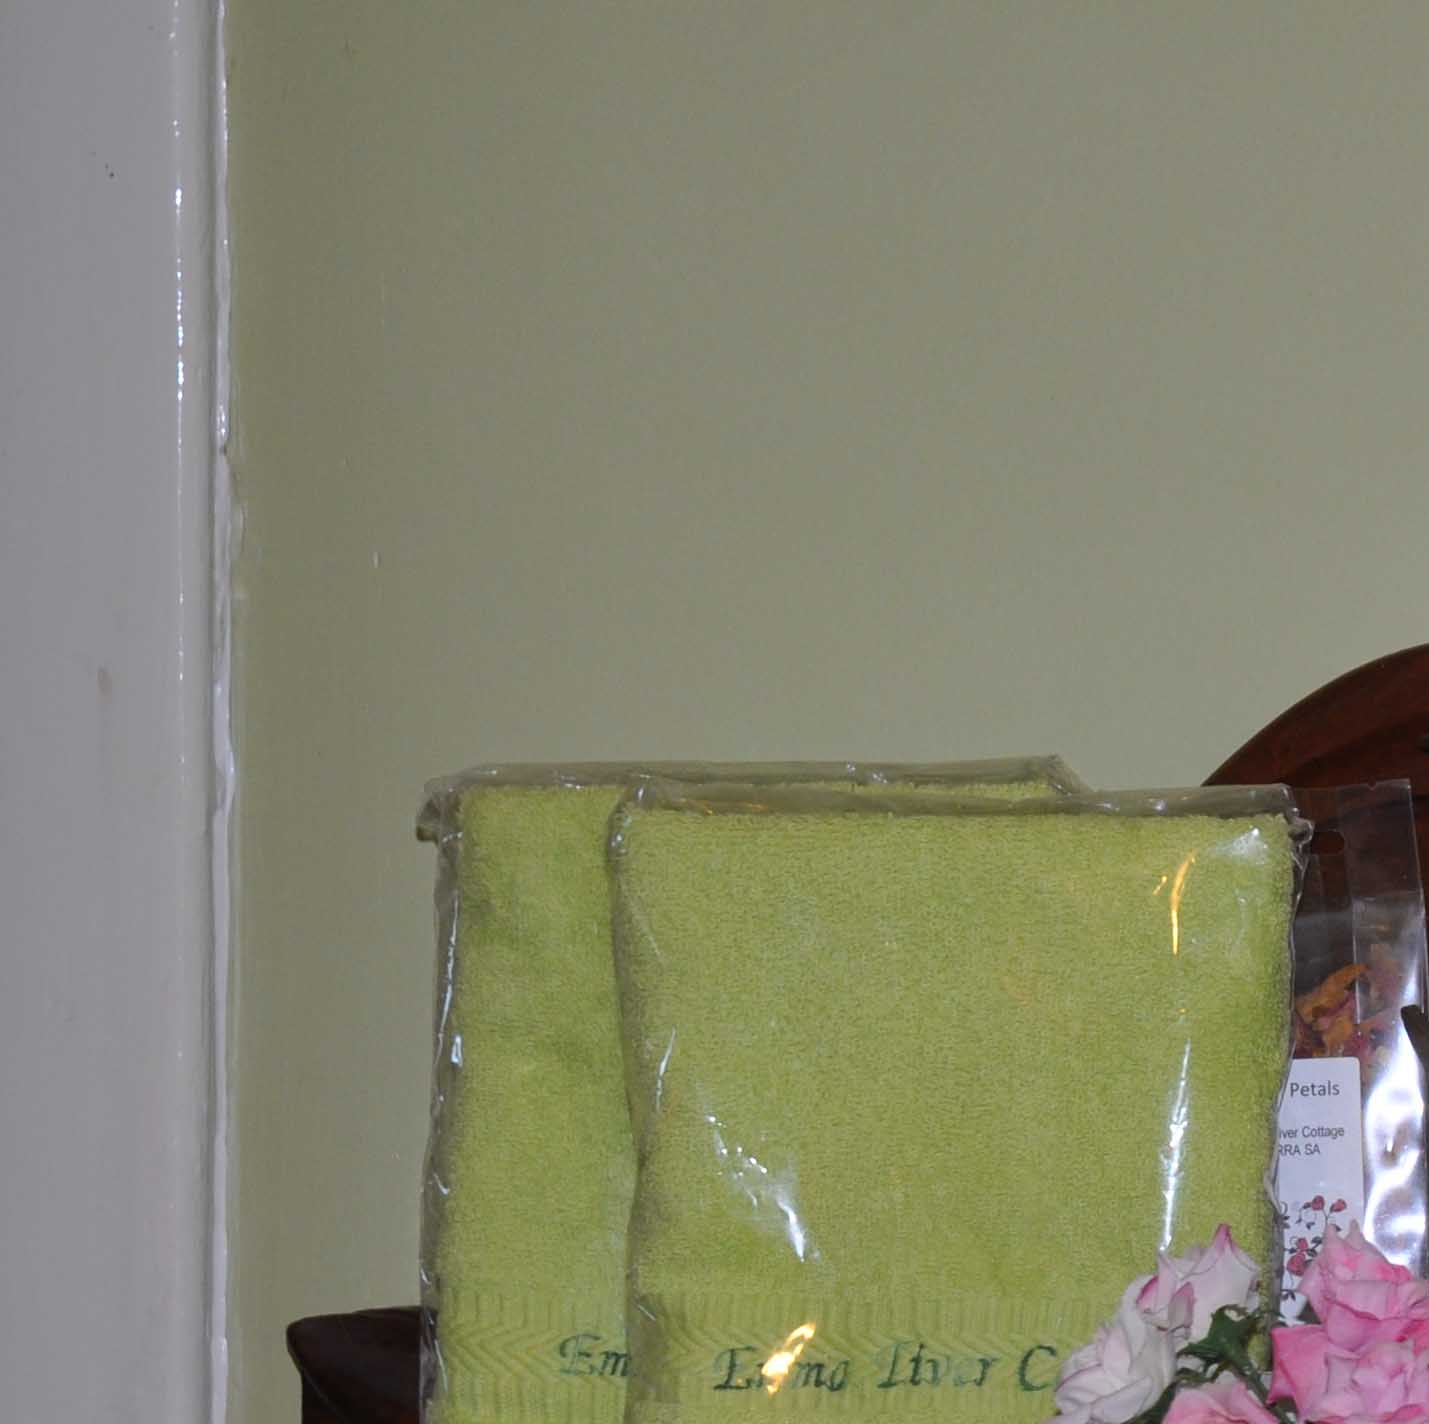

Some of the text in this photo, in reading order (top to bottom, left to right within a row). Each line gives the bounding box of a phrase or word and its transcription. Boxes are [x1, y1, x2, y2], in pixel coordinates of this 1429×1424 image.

[1290, 1080, 1340, 1097] Petals
[1278, 1126, 1345, 1140] iver Cottage
[1278, 1143, 1321, 1156] RRA SA
